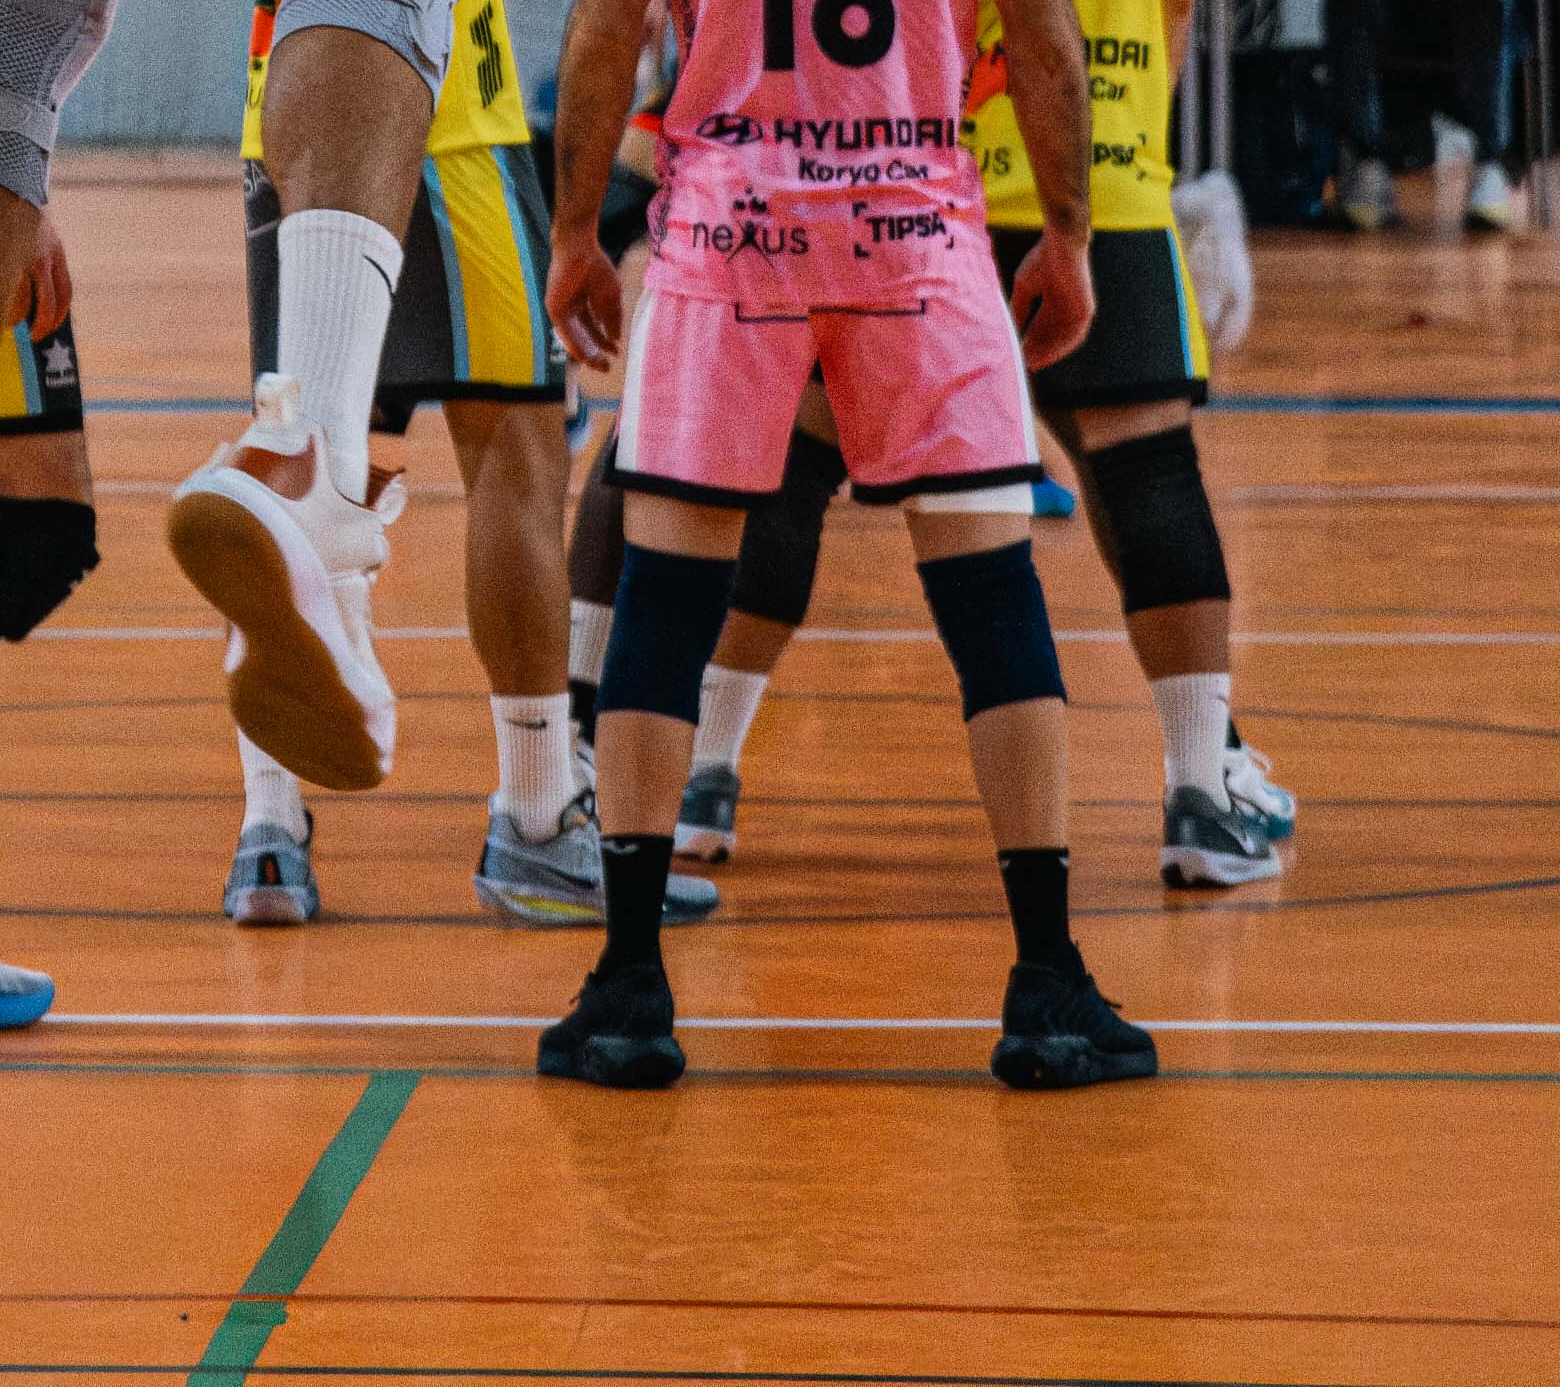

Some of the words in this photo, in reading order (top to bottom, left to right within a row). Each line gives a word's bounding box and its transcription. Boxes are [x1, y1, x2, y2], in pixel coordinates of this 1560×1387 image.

[773, 117, 955, 151] HYUNDAI
[798, 155, 880, 186] Koryo
[866, 213, 949, 244] TIPSA
